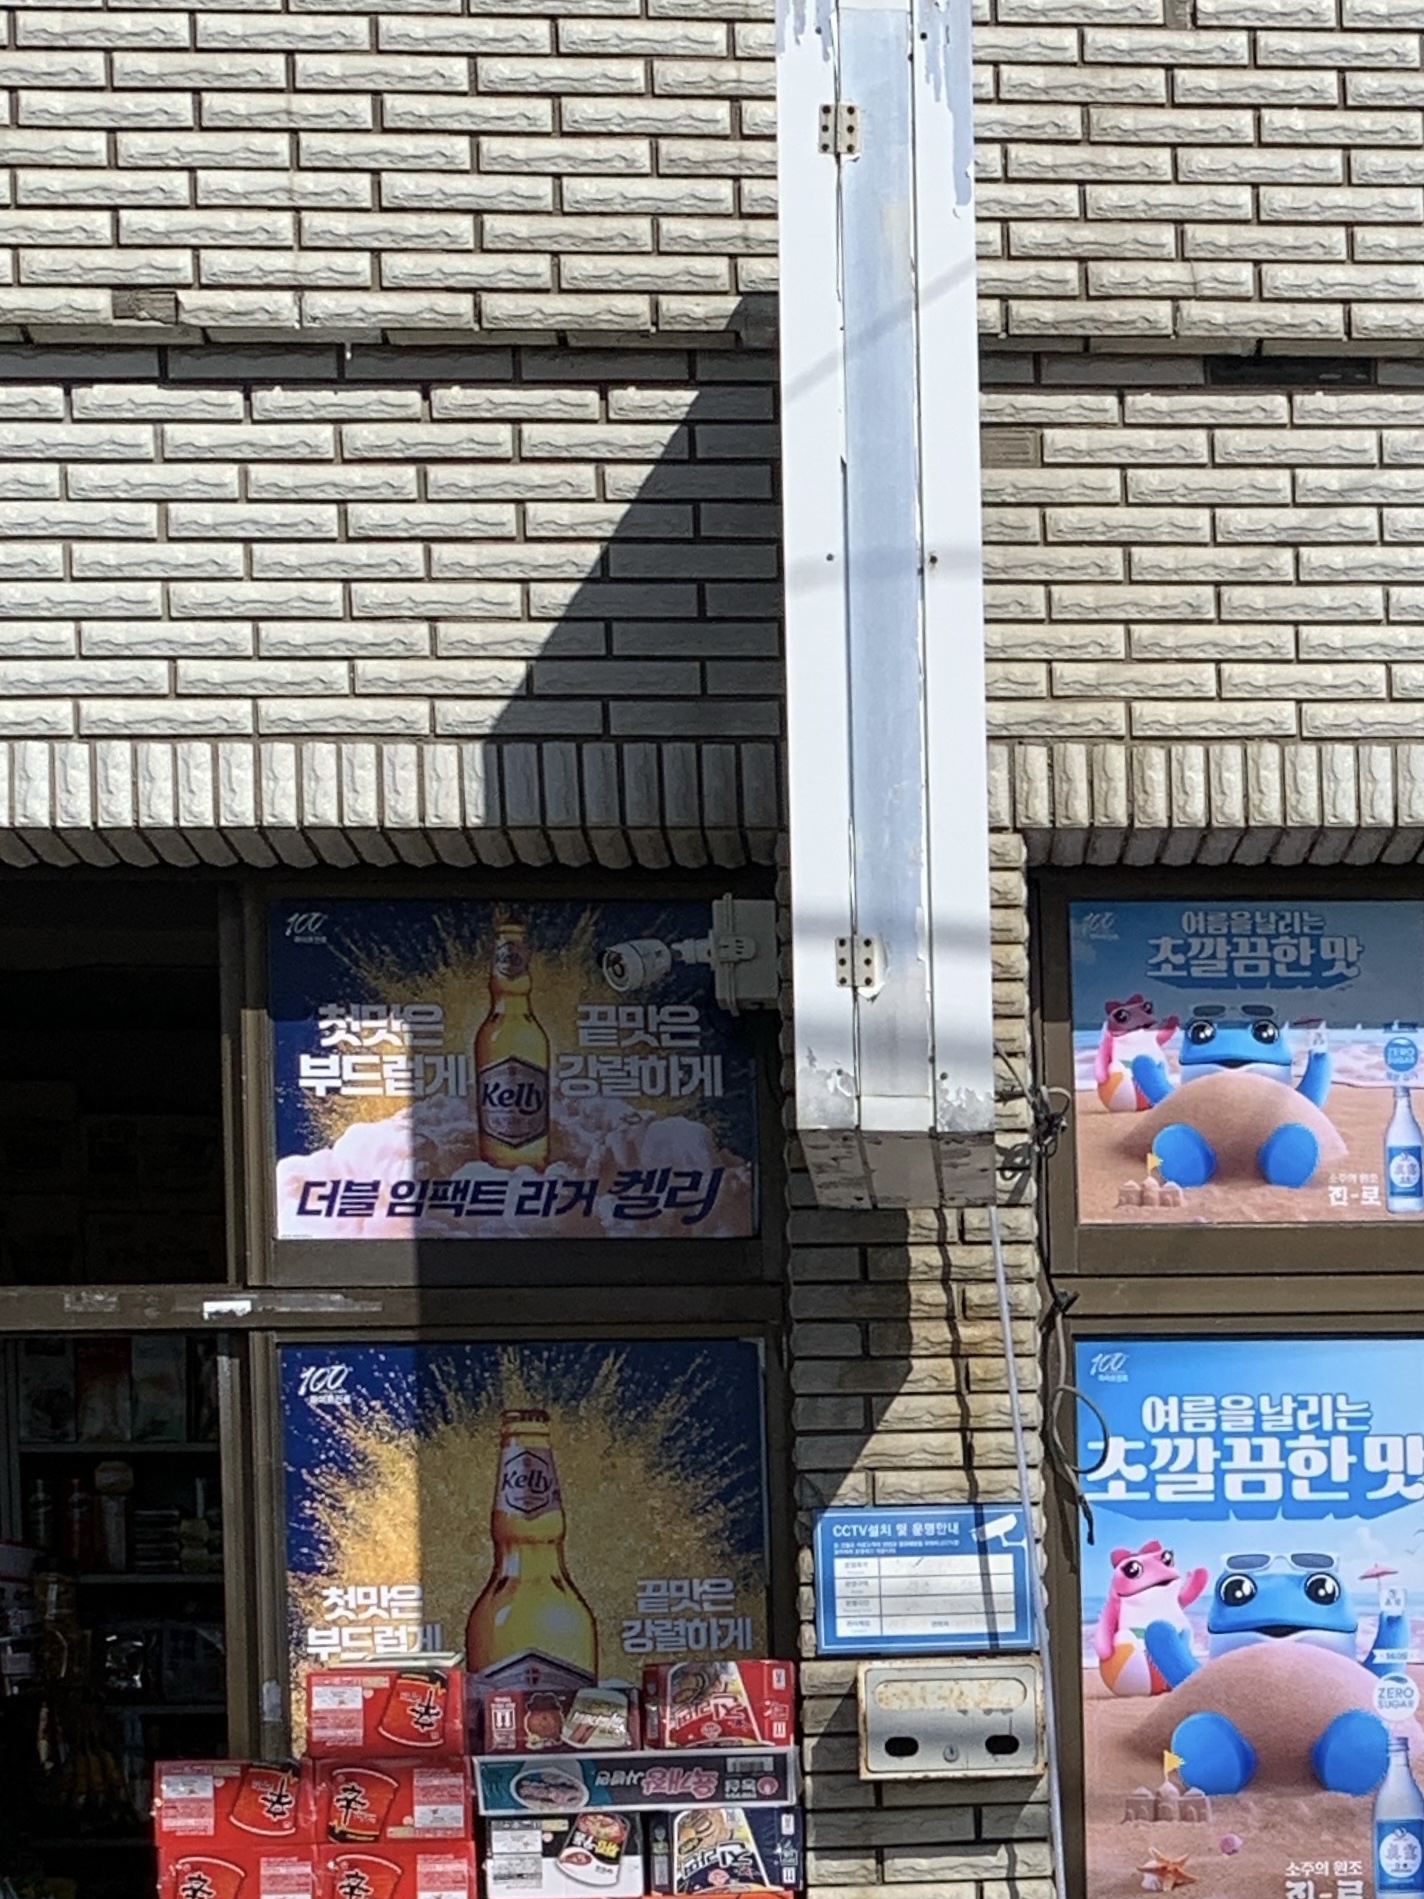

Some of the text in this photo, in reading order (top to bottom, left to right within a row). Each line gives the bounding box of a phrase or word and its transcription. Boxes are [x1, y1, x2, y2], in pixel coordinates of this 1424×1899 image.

[1146, 936, 1365, 979] 초깔끔한 맛
[319, 1003, 446, 1047] 첫맛은
[577, 1004, 701, 1048] 끝맛은
[299, 1054, 469, 1098] 부드럽게
[557, 1054, 725, 1098] 강렬하게
[481, 1080, 545, 1115] Kelly
[296, 1167, 724, 1225] 더블 임팩트 라거 켈리
[501, 1465, 553, 1495] Kelly
[1085, 1435, 1357, 1502] 초깔끔한
[322, 1585, 423, 1622] 첫맛은
[636, 1578, 735, 1614] 끝맛은
[306, 1624, 443, 1661] 부드럽게
[621, 1618, 753, 1653] 강렬하게
[1377, 1686, 1414, 1699] ZERO
[1377, 1699, 1414, 1709] SUGAR
[1285, 1861, 1362, 1877] 소주의 원조
